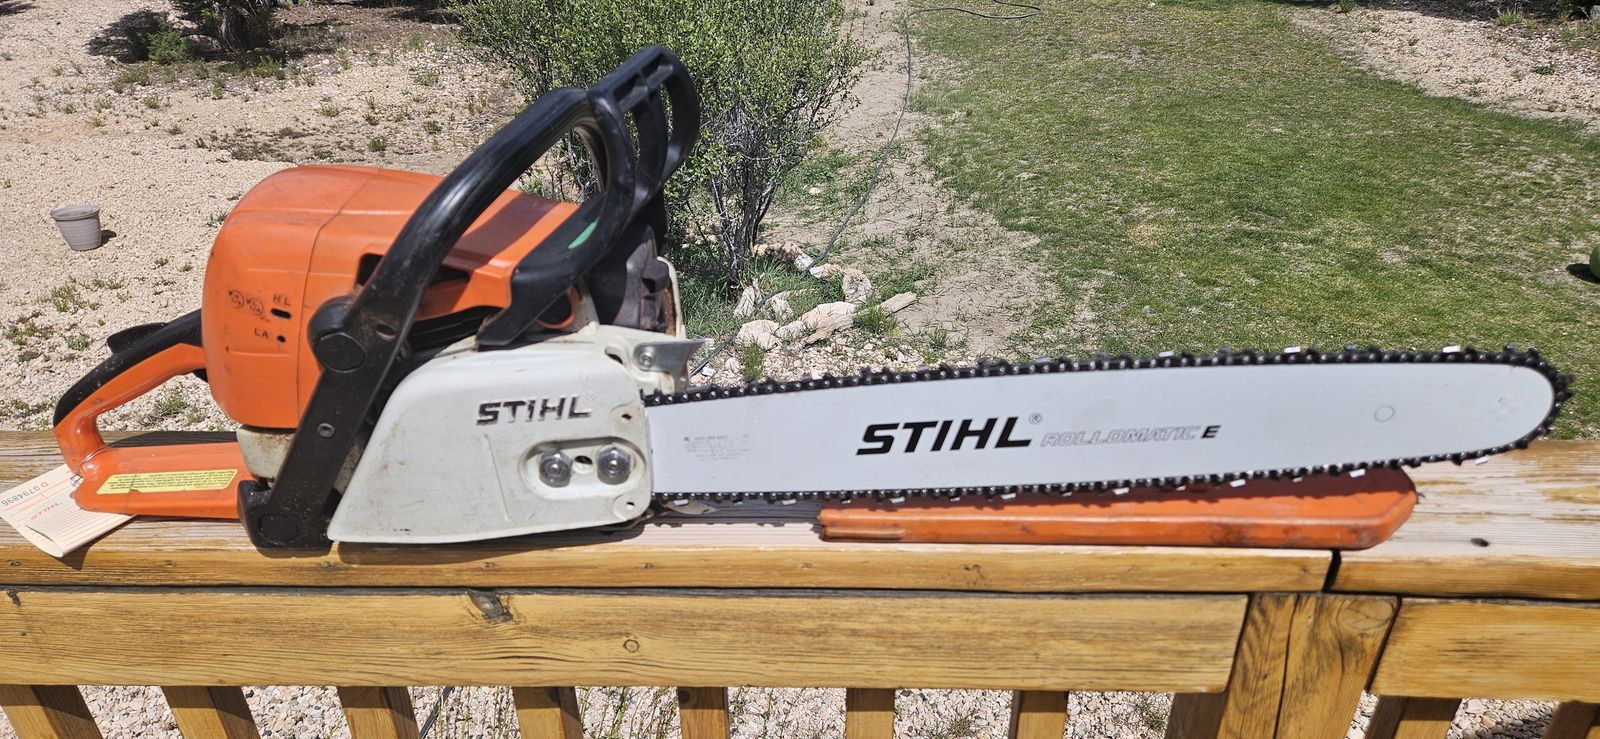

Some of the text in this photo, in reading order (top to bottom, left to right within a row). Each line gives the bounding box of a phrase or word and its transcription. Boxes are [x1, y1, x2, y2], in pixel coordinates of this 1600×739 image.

[476, 396, 592, 426] STIHL
[1040, 424, 1221, 448] ROLLOMATIC E
